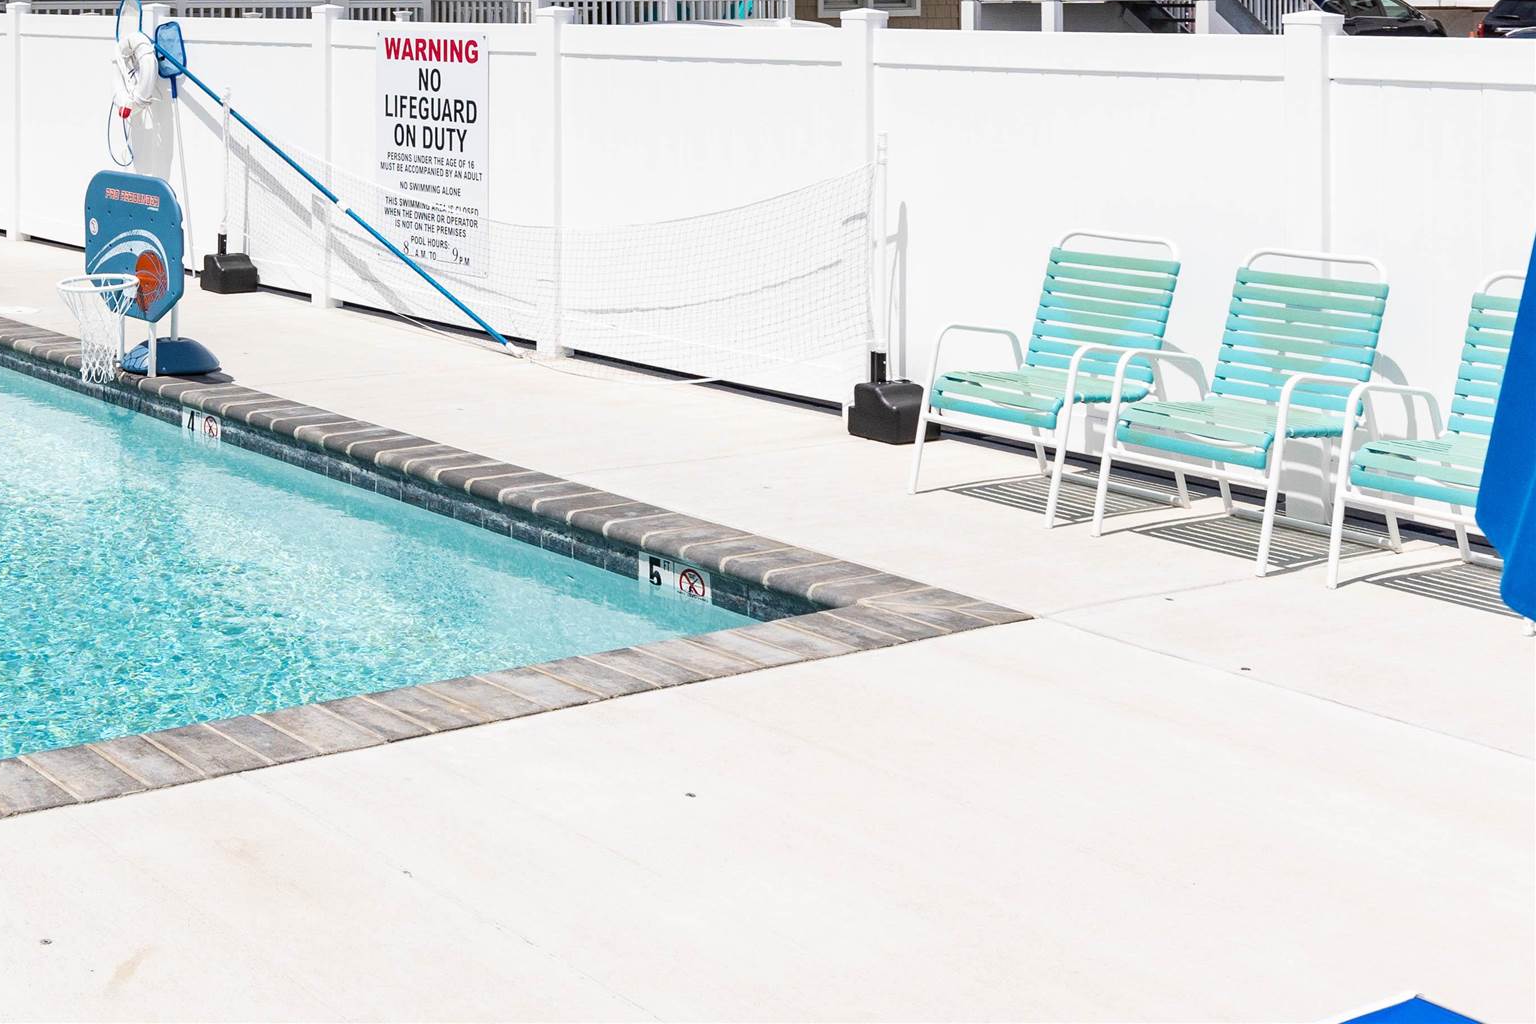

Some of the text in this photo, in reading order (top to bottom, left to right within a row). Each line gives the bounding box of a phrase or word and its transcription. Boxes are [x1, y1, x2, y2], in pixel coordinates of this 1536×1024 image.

[384, 37, 479, 64] WARNING
[418, 67, 441, 92] NO
[385, 94, 478, 124] LIFEGUARD
[394, 123, 467, 153] ON DUTY
[387, 151, 475, 169] PERSONS UNDER THE AGE OF 16
[380, 161, 482, 181] MUST BE ACCOMPANIED BY AN ADULT
[399, 181, 461, 196] NO SWIMMING ALONE
[385, 196, 397, 206] THIS
[399, 198, 430, 210] SWIMMING
[384, 207, 478, 228] WHEN THE OWNER OR OPERATOR
[395, 219, 467, 238] IS NOT ON THE PREMISES
[403, 240, 409, 255] 8
[429, 251, 437, 260] TO
[452, 247, 459, 262] 9
[411, 235, 426, 246] POOL
[649, 556, 662, 586] 5
